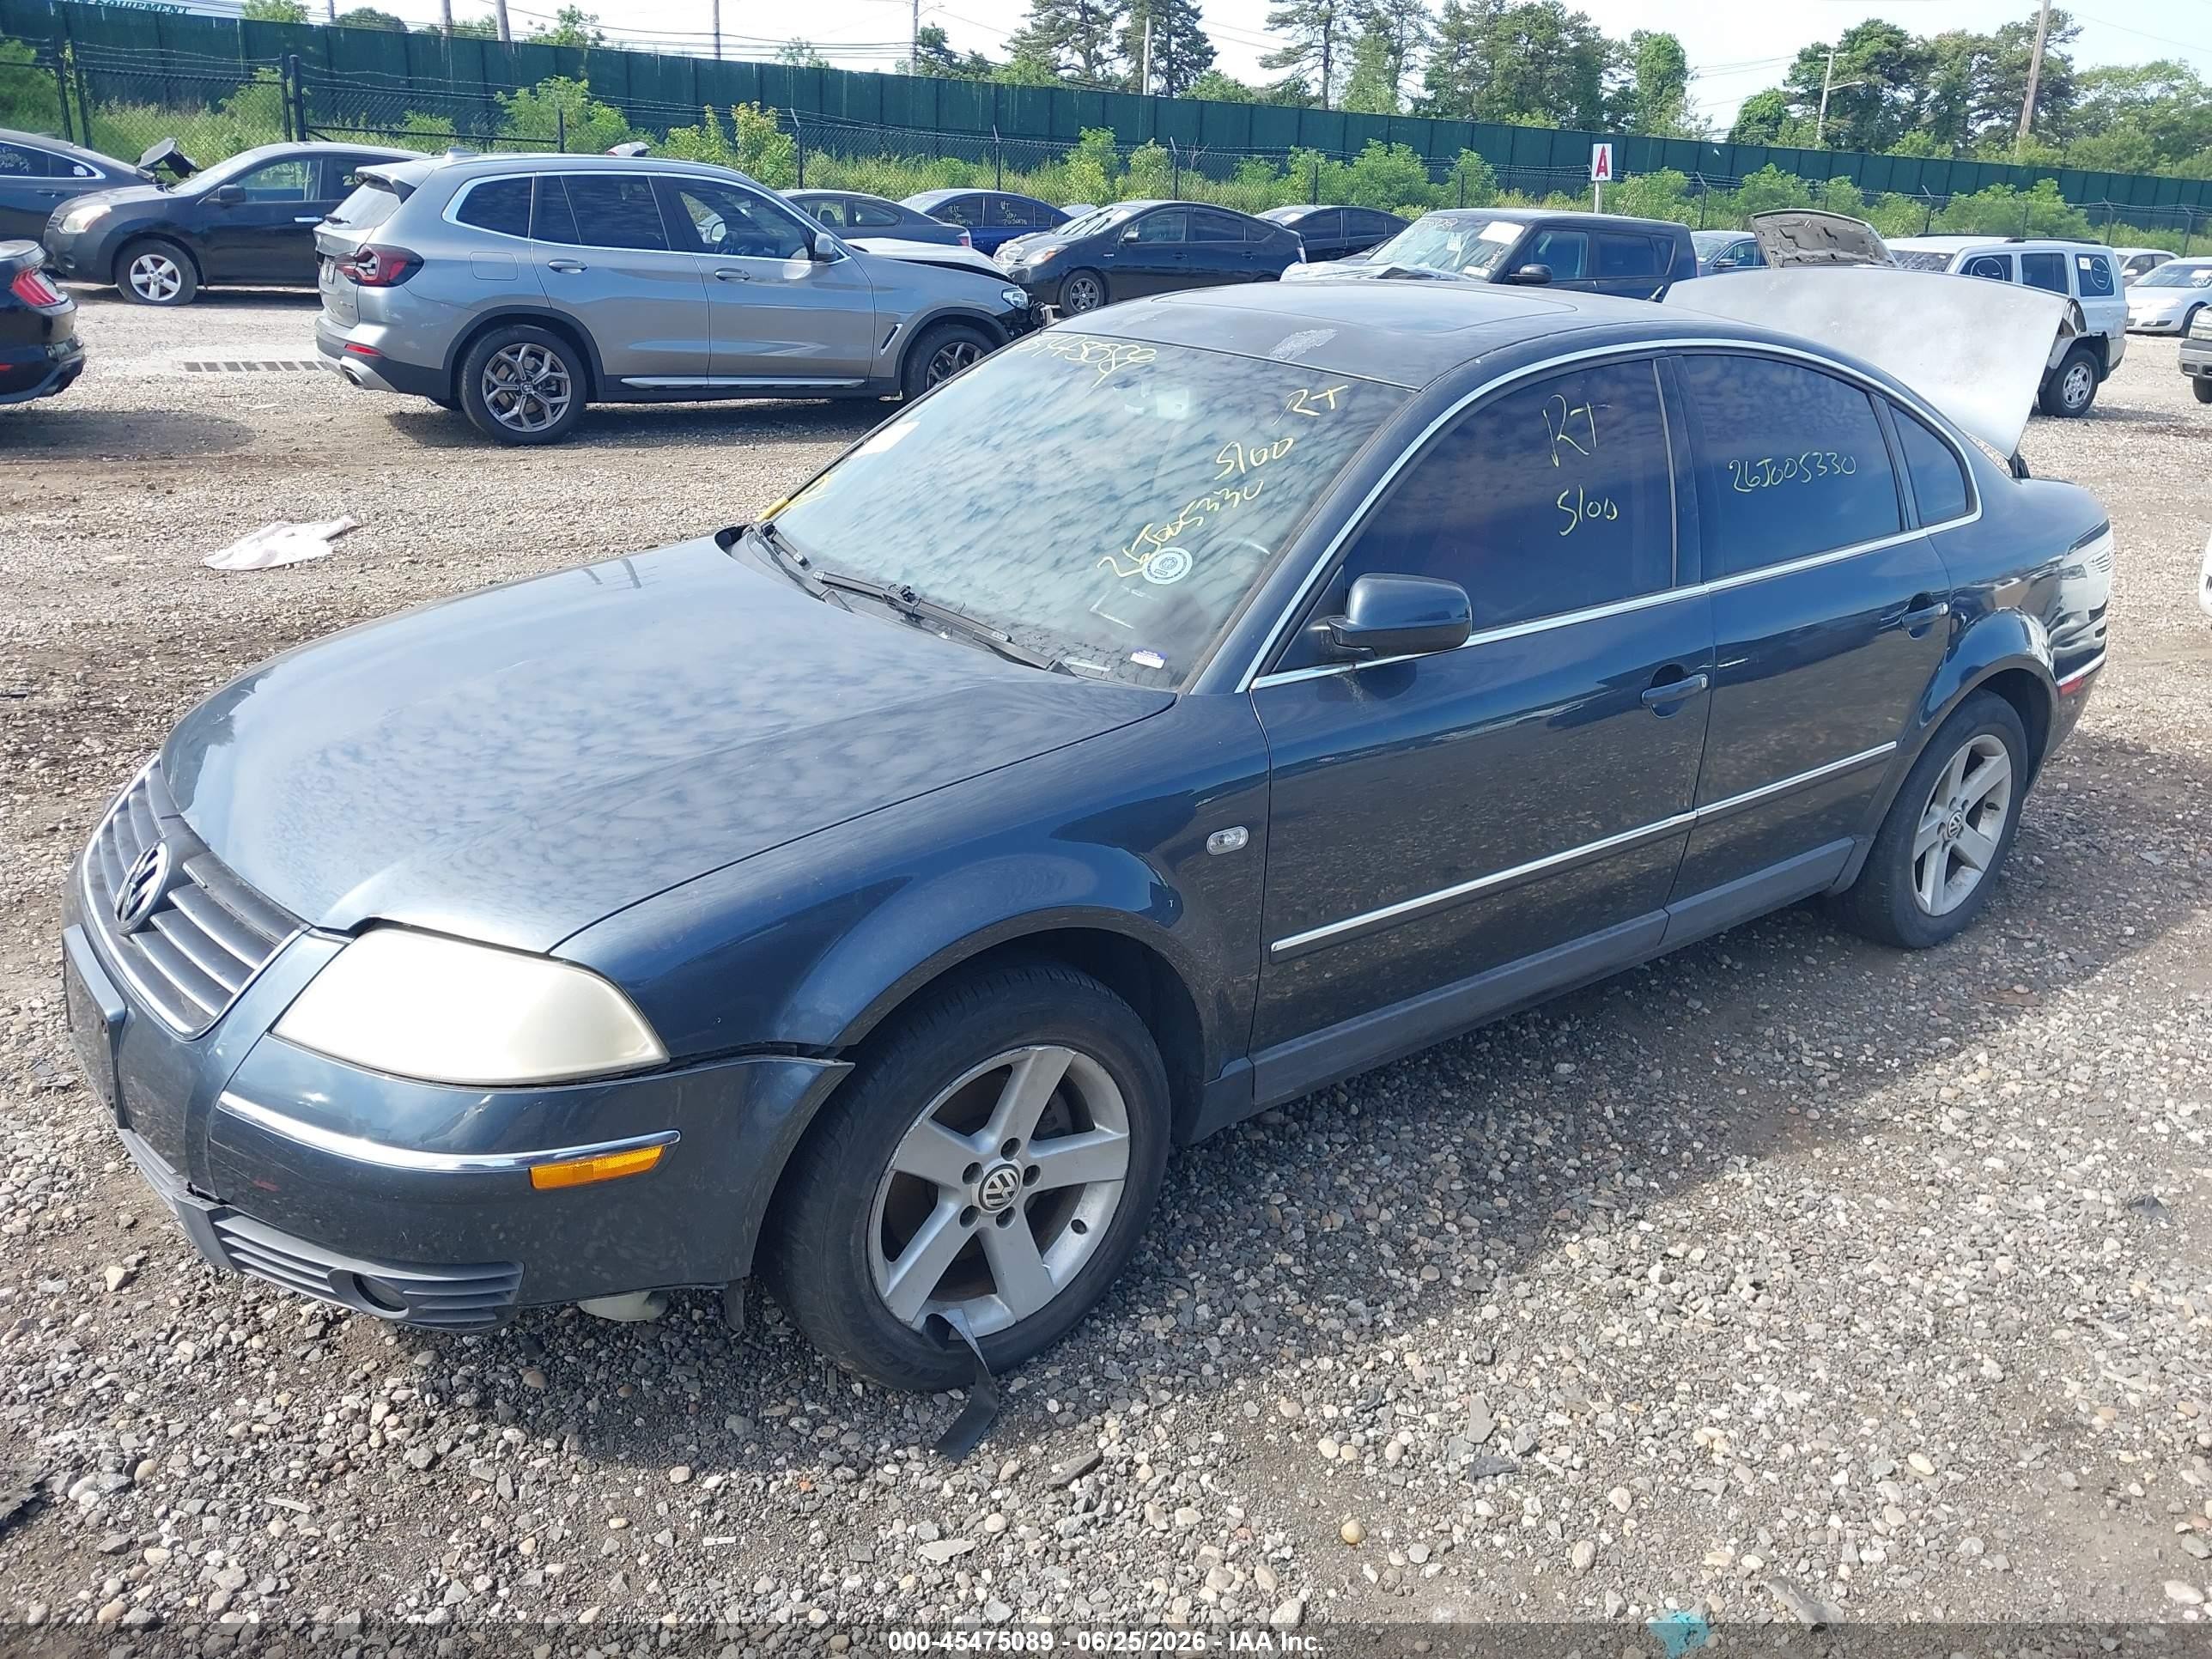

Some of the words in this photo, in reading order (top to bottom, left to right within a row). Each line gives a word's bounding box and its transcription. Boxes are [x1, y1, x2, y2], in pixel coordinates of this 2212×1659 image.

[1595, 144, 1608, 177] A
[1271, 385, 1349, 427] RT
[1542, 394, 1613, 467] RT
